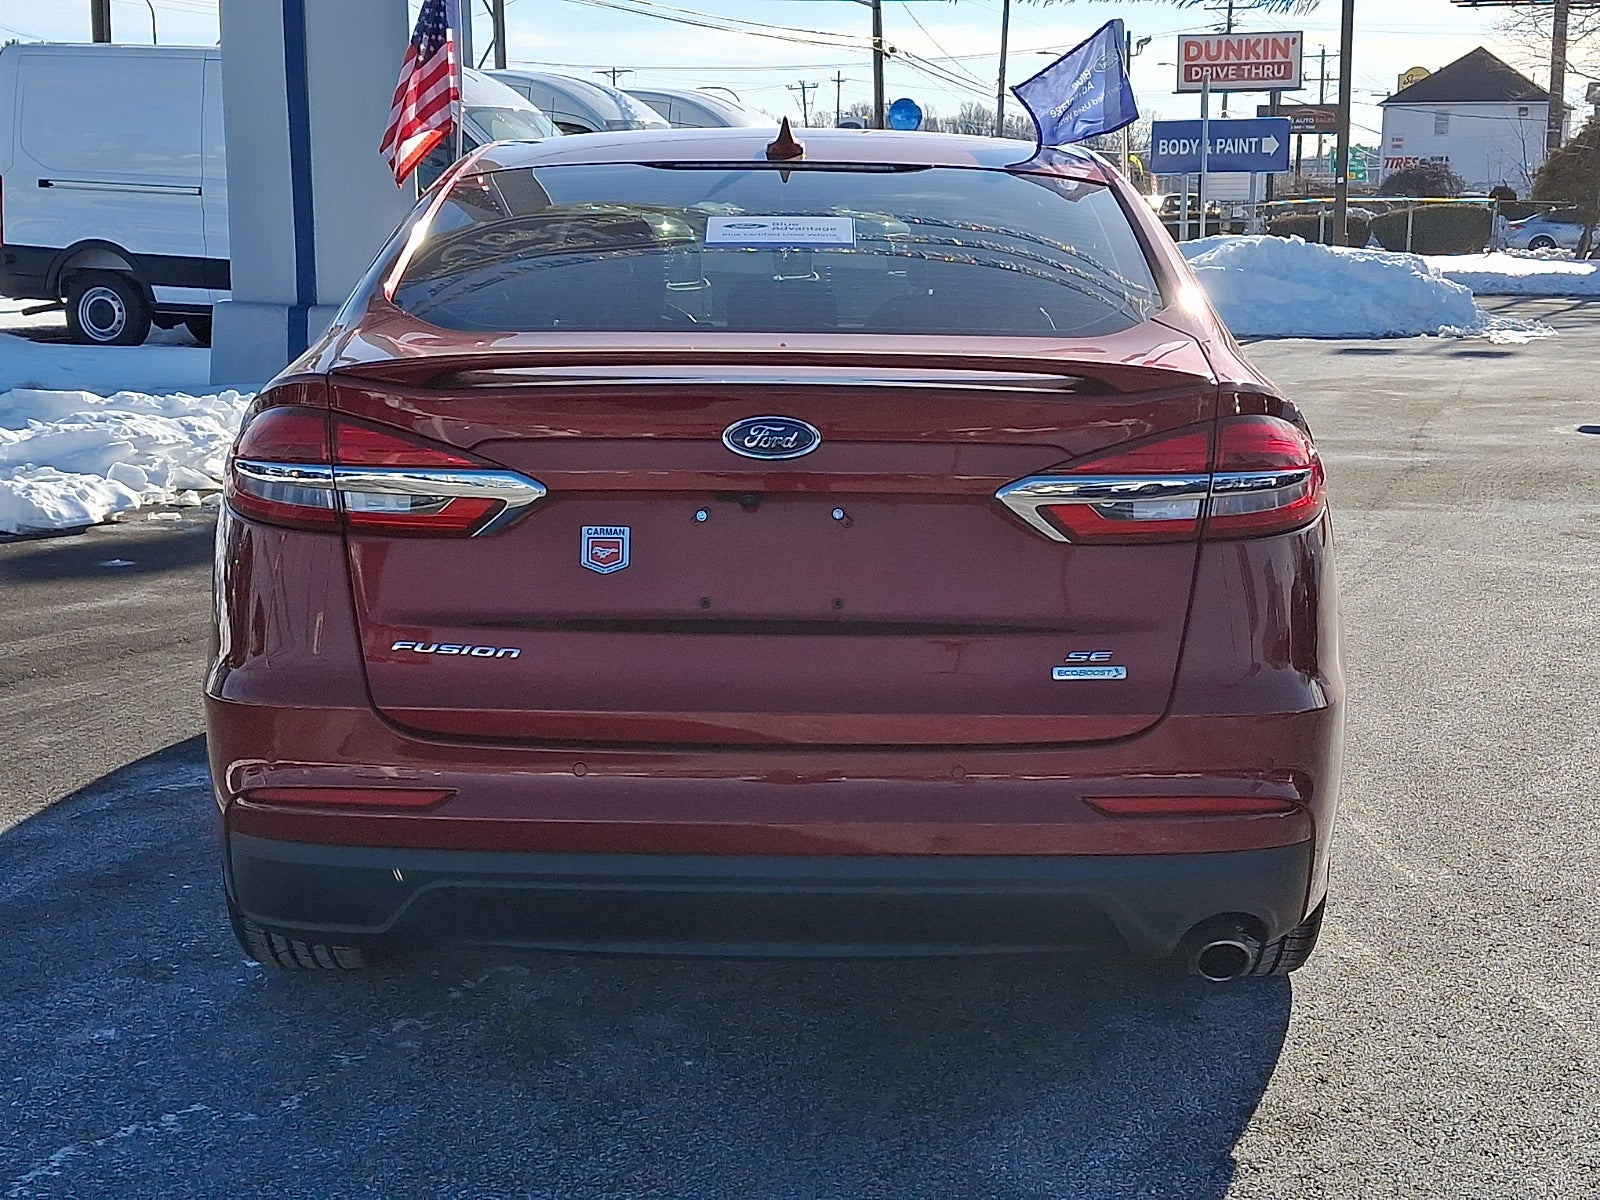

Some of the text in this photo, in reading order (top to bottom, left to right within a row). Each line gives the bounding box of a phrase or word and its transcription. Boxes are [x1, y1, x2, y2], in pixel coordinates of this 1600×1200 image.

[1184, 37, 1297, 62] DUNKIN'
[1191, 64, 1285, 80] DRIVE THRU
[1158, 139, 1200, 155] BODY
[1216, 137, 1259, 154] PAINT
[1384, 156, 1419, 170] TIRES
[743, 424, 799, 448] Ford
[586, 527, 626, 536] CARMAN
[391, 641, 521, 658] FUSION
[1064, 651, 1113, 662] SE
